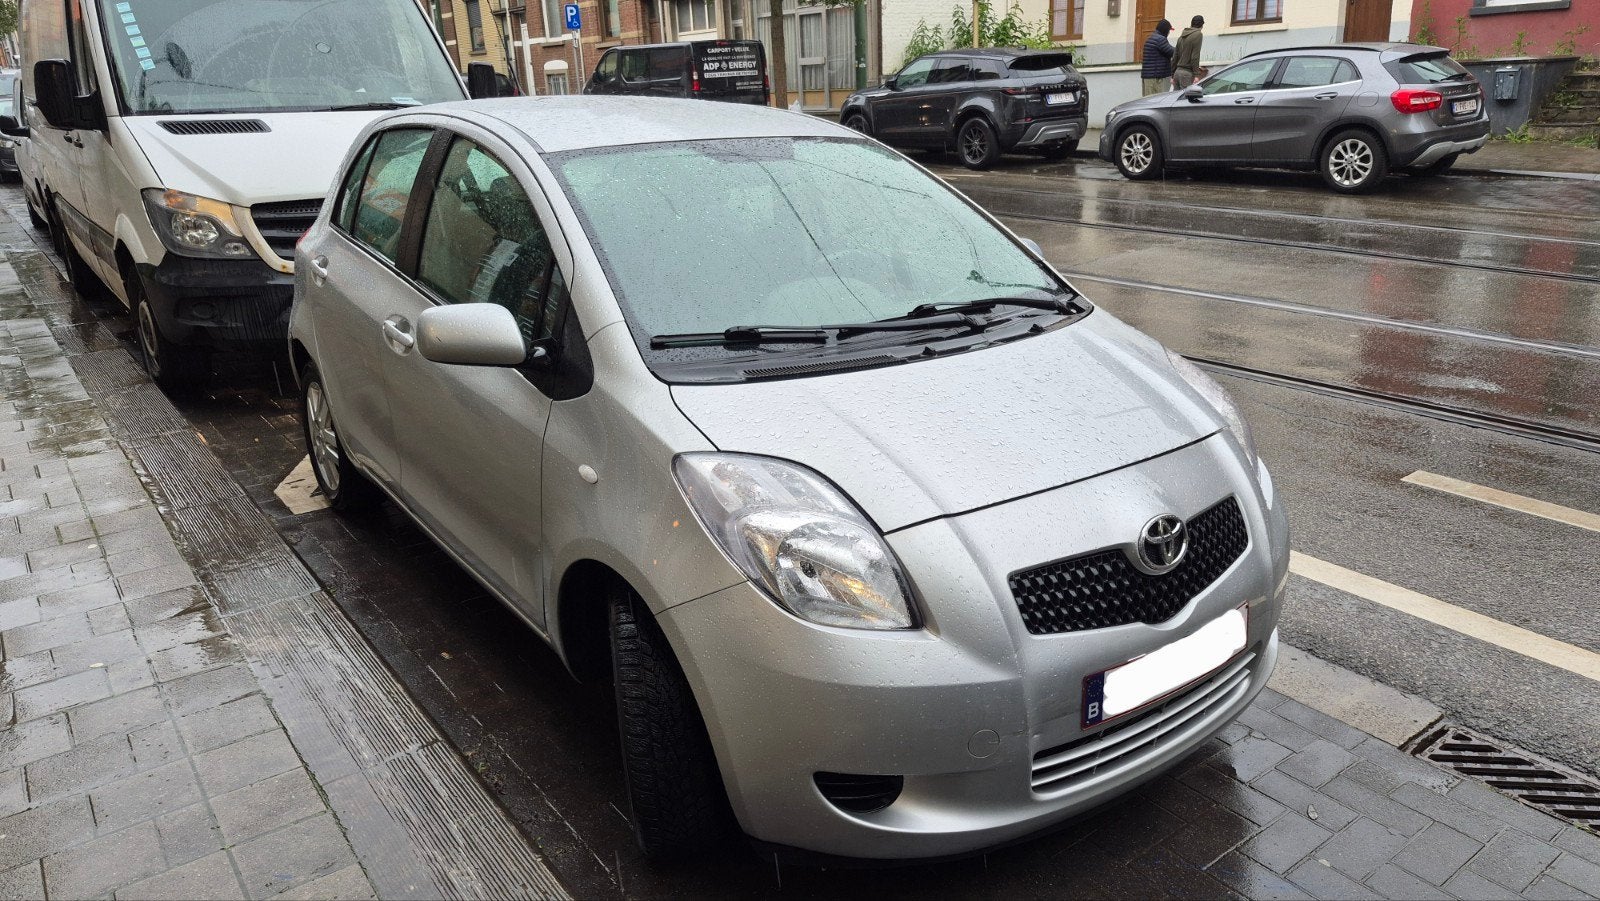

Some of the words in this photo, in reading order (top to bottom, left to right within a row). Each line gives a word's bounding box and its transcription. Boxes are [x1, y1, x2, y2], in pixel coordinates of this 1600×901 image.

[566, 6, 577, 22] P
[703, 62, 720, 71] ADP
[728, 60, 757, 69] ENERGY
[1088, 702, 1099, 719] B
